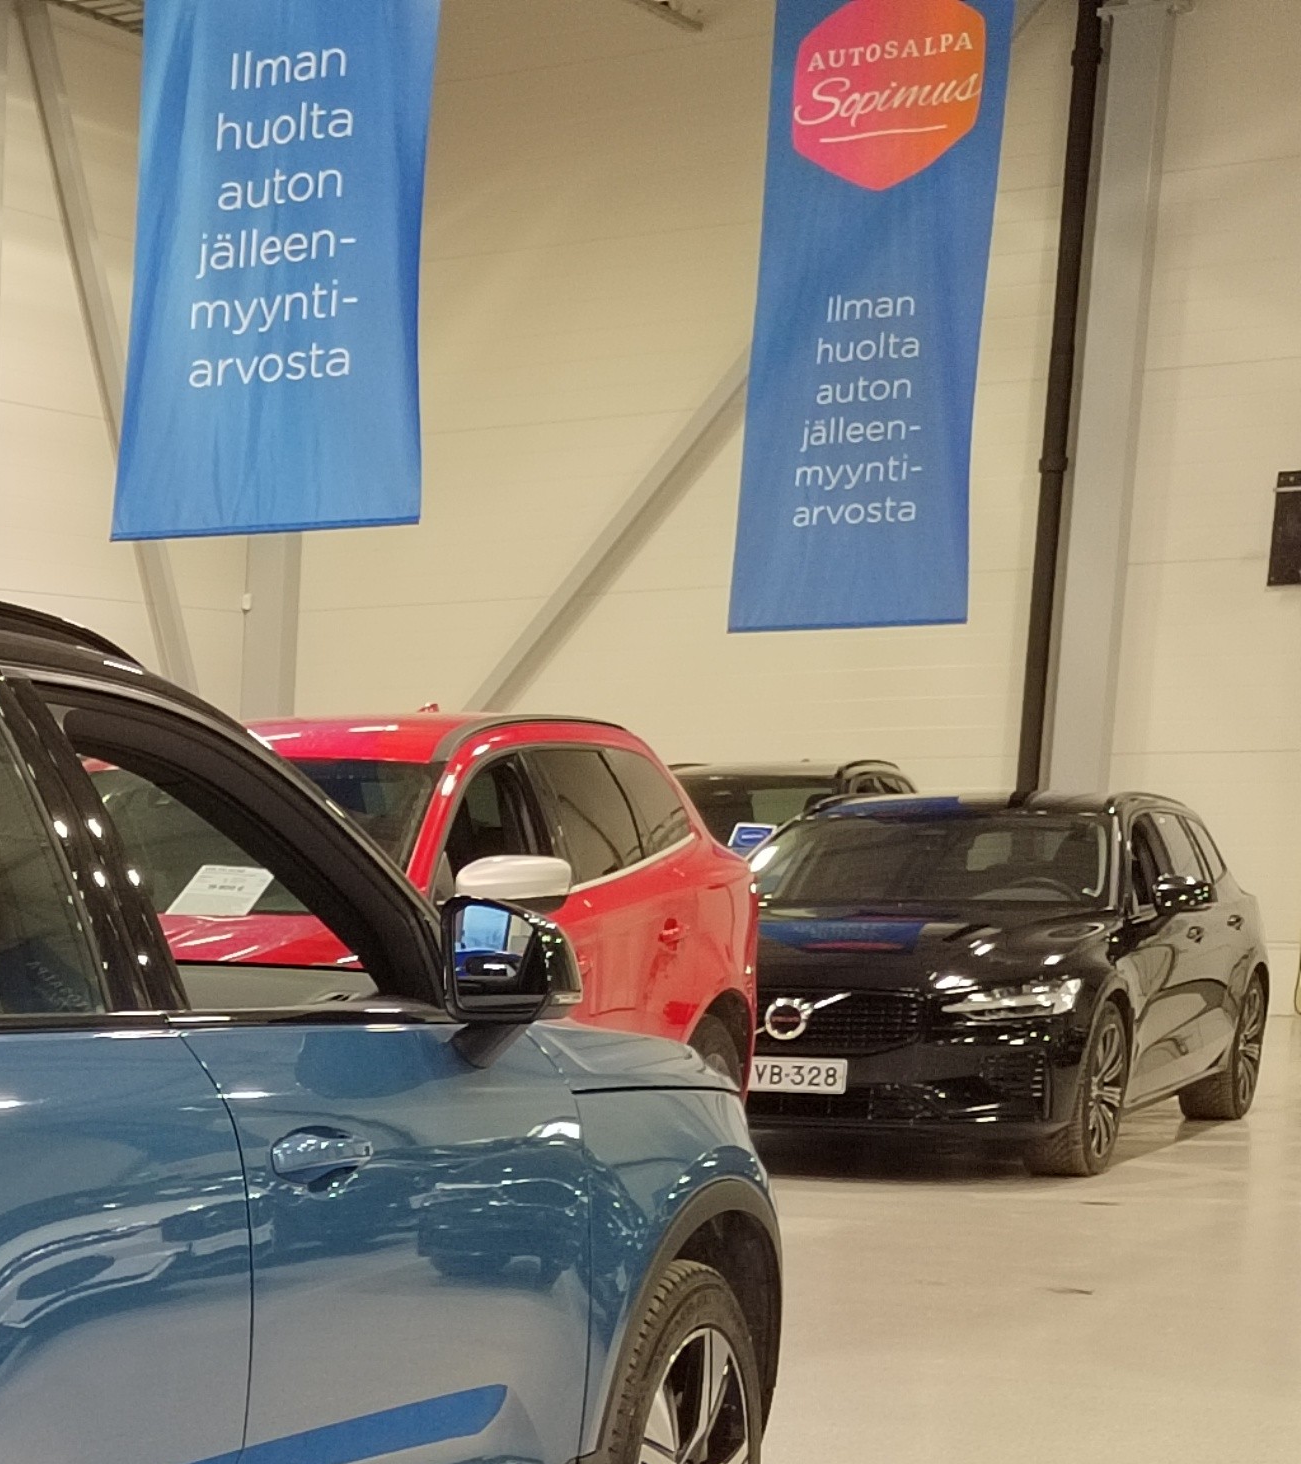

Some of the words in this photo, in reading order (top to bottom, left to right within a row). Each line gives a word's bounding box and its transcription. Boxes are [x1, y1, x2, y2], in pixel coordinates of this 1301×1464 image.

[229, 46, 348, 91] Ilman
[807, 31, 974, 72] AUTOSALPA
[793, 72, 983, 128] Sopimus
[216, 102, 354, 152] huolta
[217, 168, 343, 211] auton
[195, 227, 357, 279] jälleen-
[190, 280, 359, 335] myynti-
[827, 294, 915, 323] Ilman
[188, 342, 351, 388] arvosta
[816, 331, 920, 365] huolta
[816, 376, 912, 405] auton
[800, 416, 921, 452] jälleen-
[795, 453, 922, 490] myynti-
[792, 496, 916, 527] arvosta
[754, 1064, 838, 1087] VB-328
